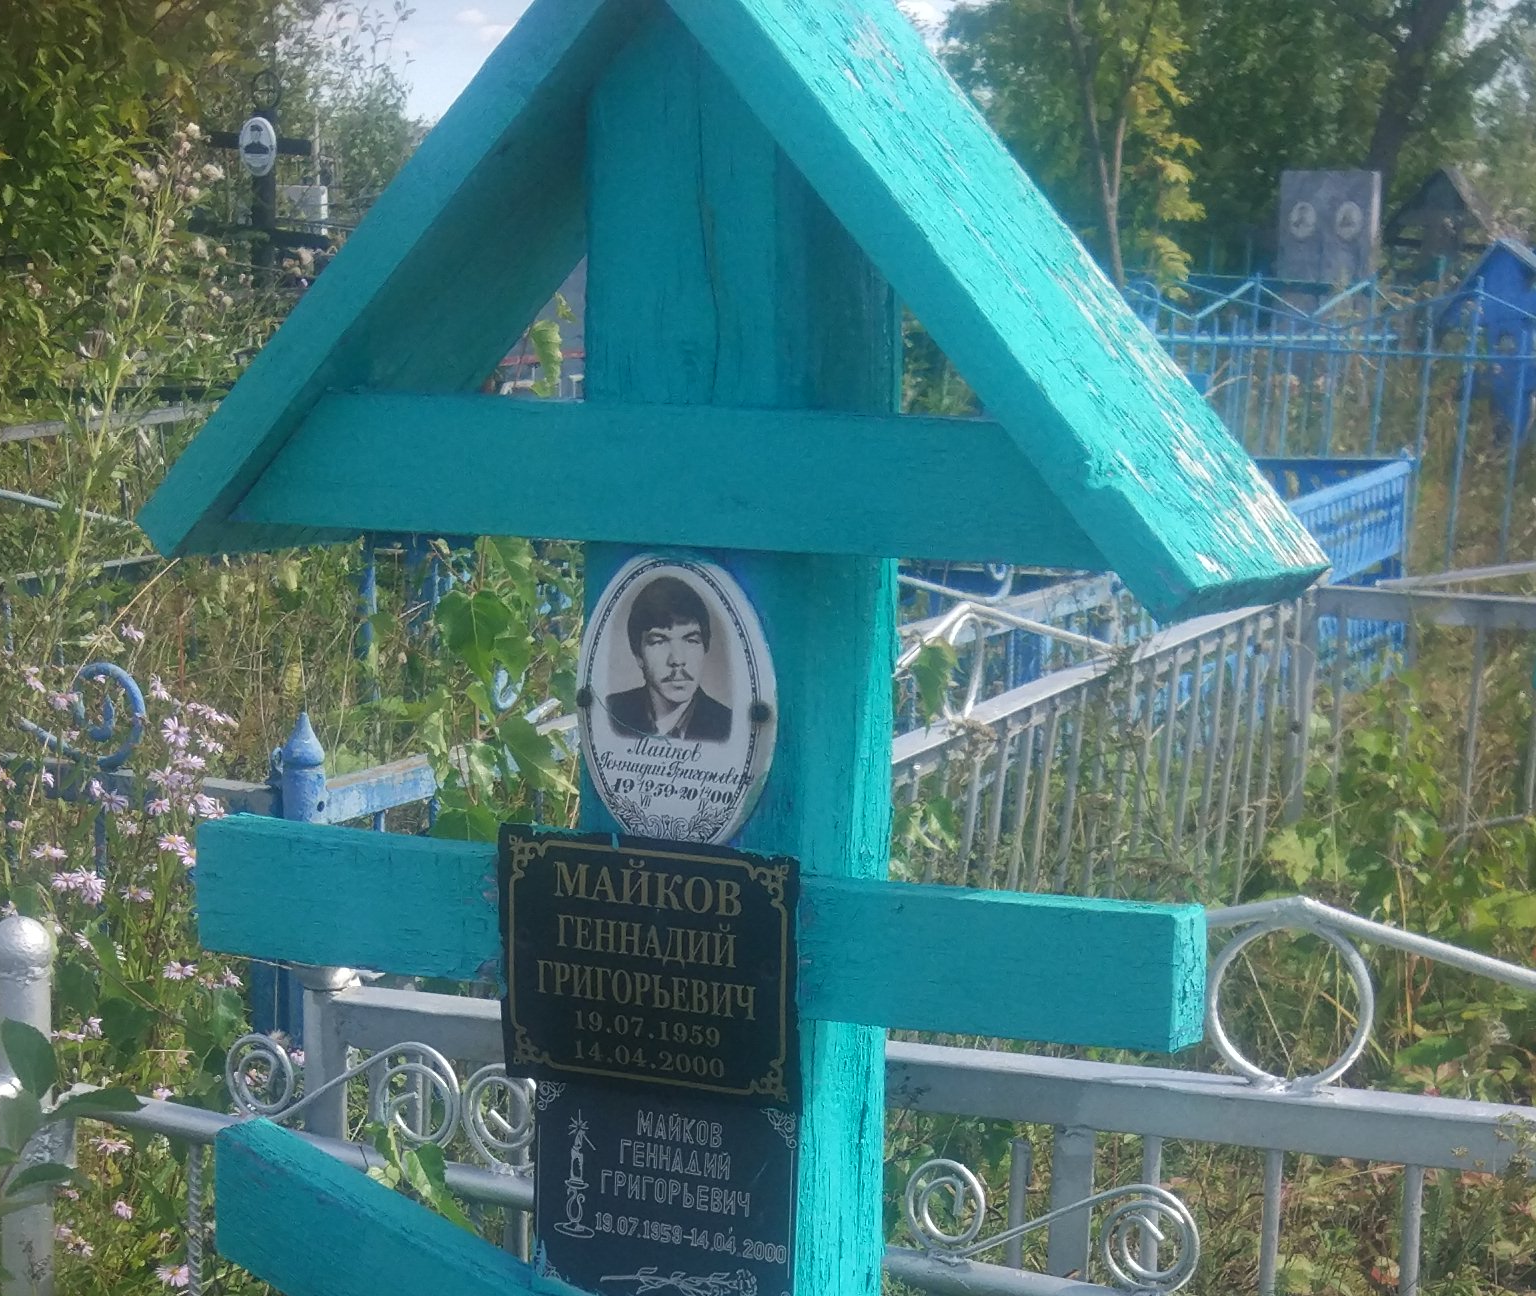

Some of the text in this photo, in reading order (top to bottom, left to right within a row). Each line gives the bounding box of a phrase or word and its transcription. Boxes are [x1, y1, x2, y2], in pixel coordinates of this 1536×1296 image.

[627, 737, 702, 762] Майков
[553, 858, 743, 917] МАЙКОВ
[556, 913, 737, 969] ГЕННАДИЙ
[536, 959, 757, 1021] ГРИГОРЬЕВИЧ
[574, 1009, 721, 1048] 19.07.1959
[573, 1040, 725, 1079] 14.04.2000
[636, 1109, 723, 1148] МАЙКОВ
[619, 1138, 732, 1181] ГЕННАДИЙ
[600, 1169, 751, 1218] ГРИГОРЬЕВИЧ
